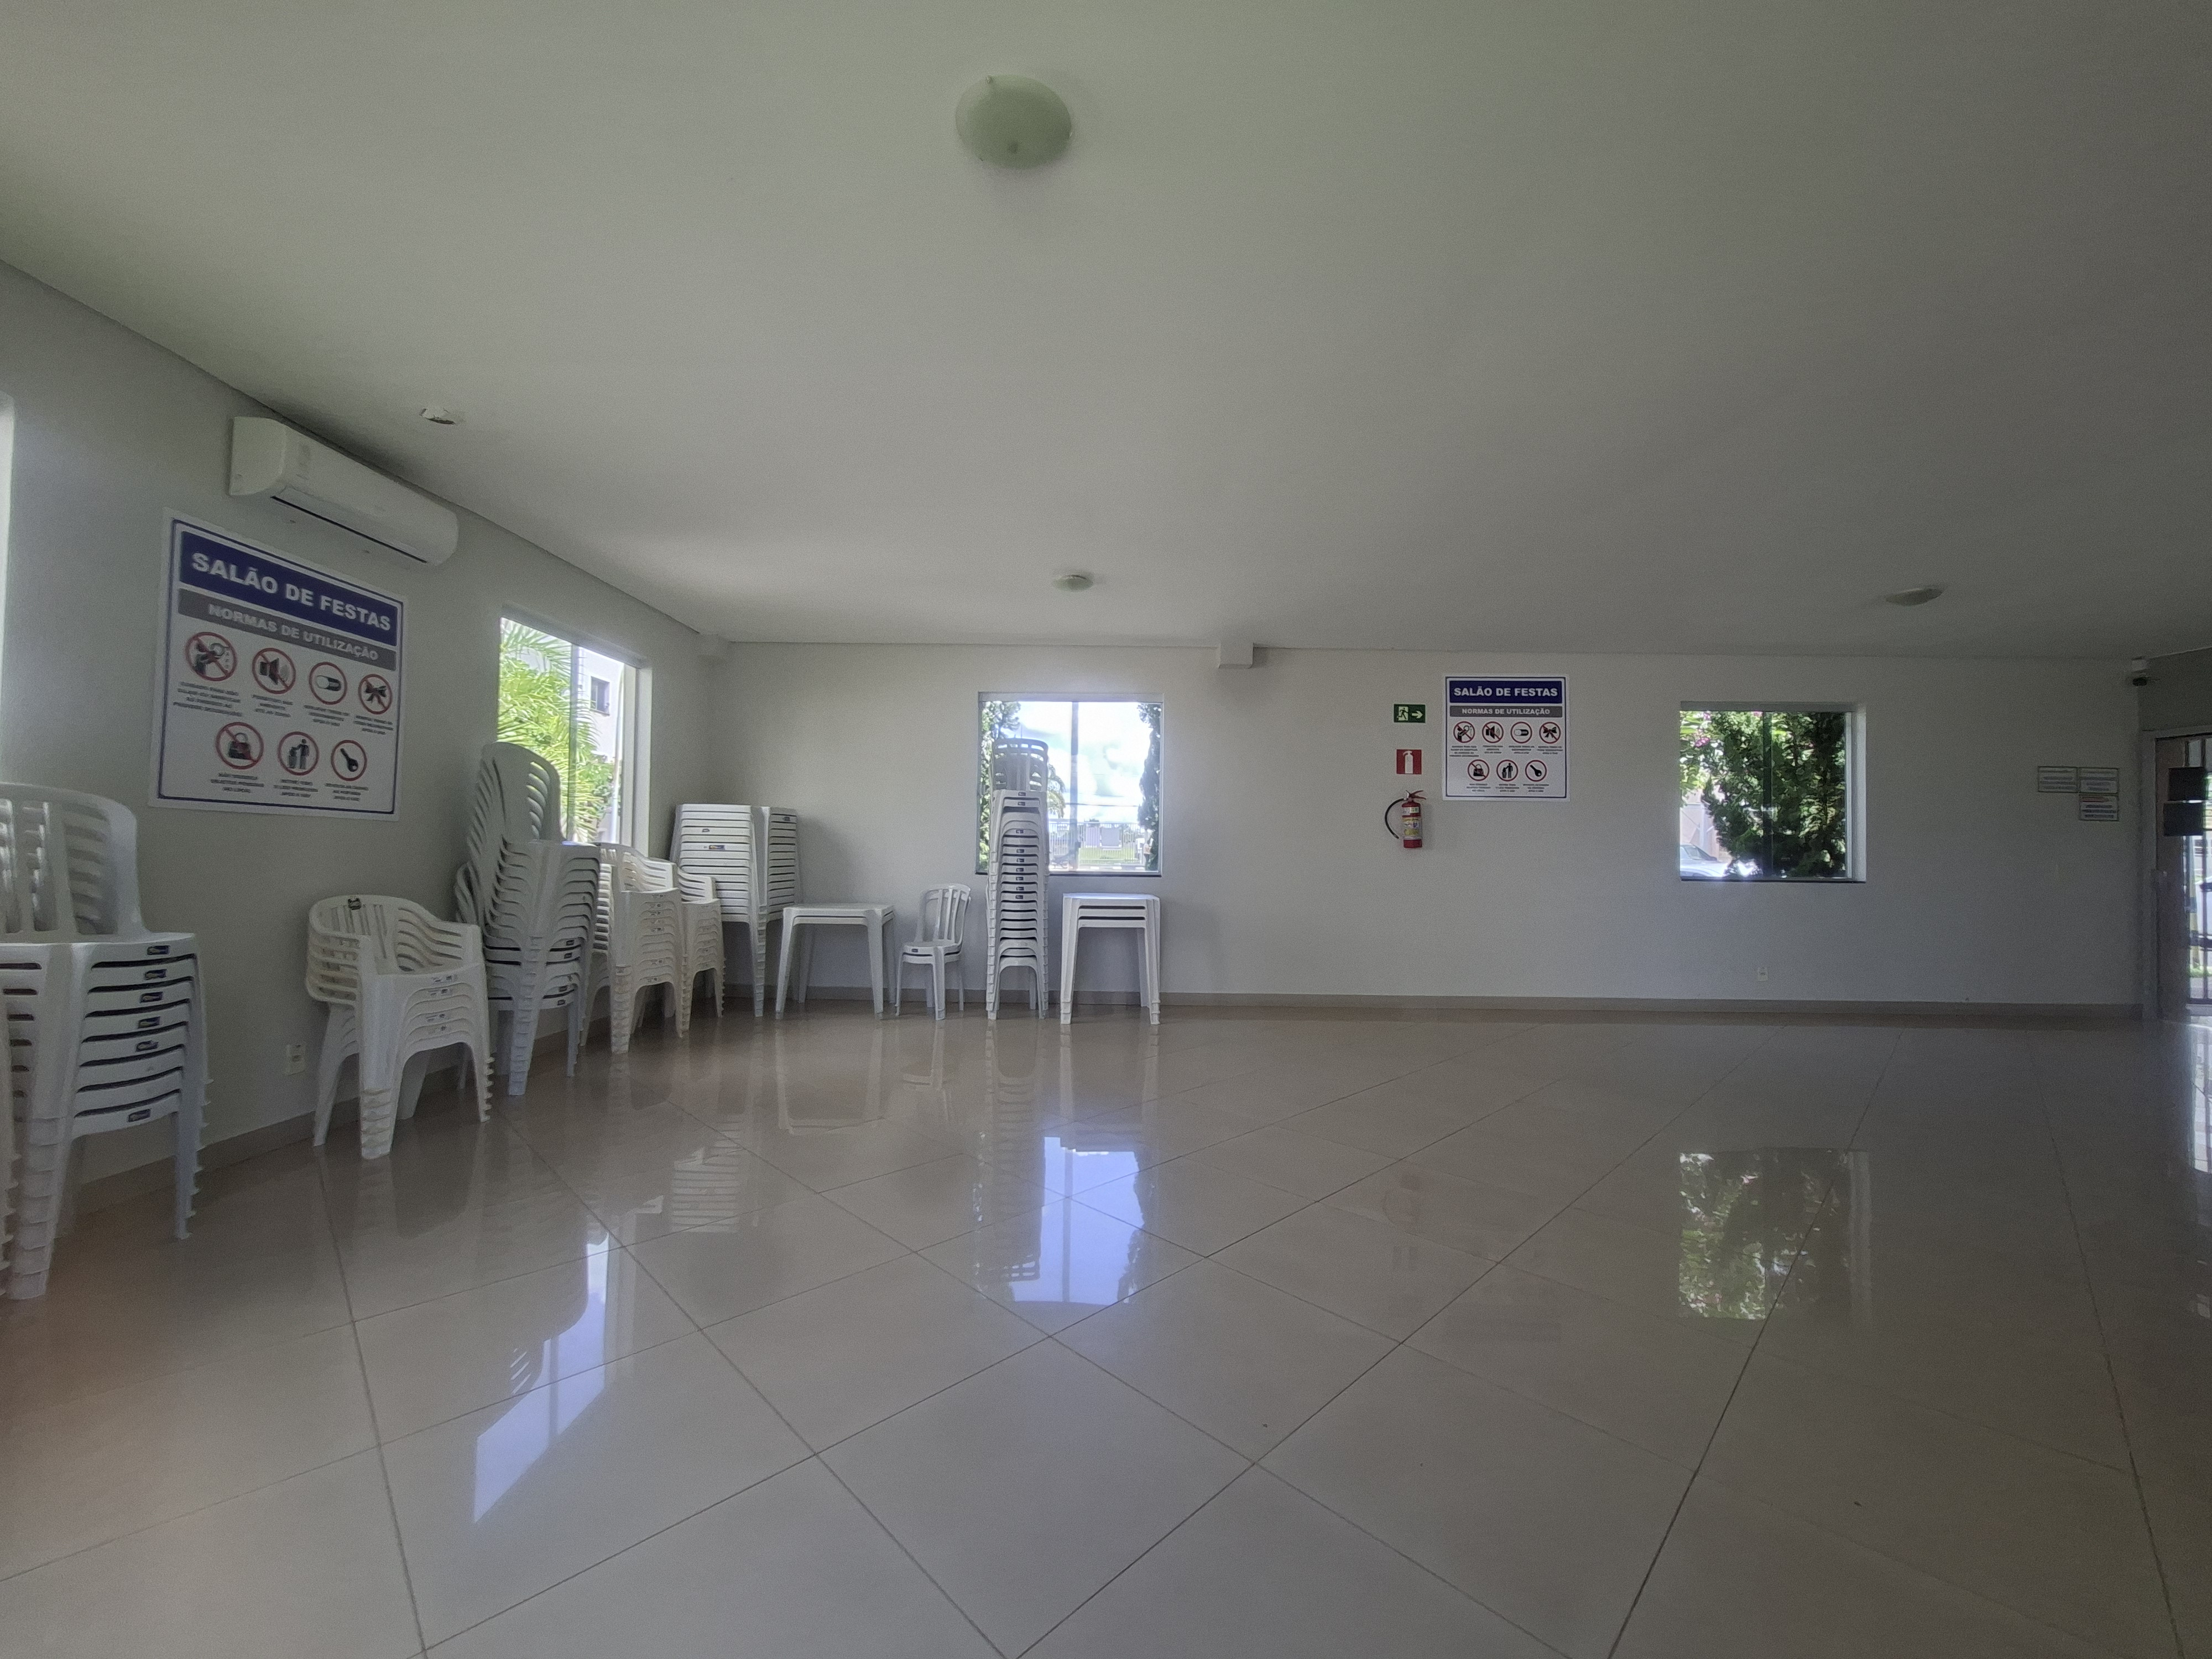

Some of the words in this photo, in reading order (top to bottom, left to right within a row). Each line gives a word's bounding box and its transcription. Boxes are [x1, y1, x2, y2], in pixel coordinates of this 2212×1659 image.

[191, 552, 278, 594] SALÃO
[285, 583, 314, 607] DE
[320, 595, 391, 631] FESTAS
[208, 604, 277, 632] NORMAS
[281, 625, 300, 639] DE
[303, 630, 378, 660] UTILIZAÇÃO
[1454, 686, 1493, 696] SALÃO
[1496, 688, 1511, 696] DE
[1514, 688, 1558, 696] FESTAS
